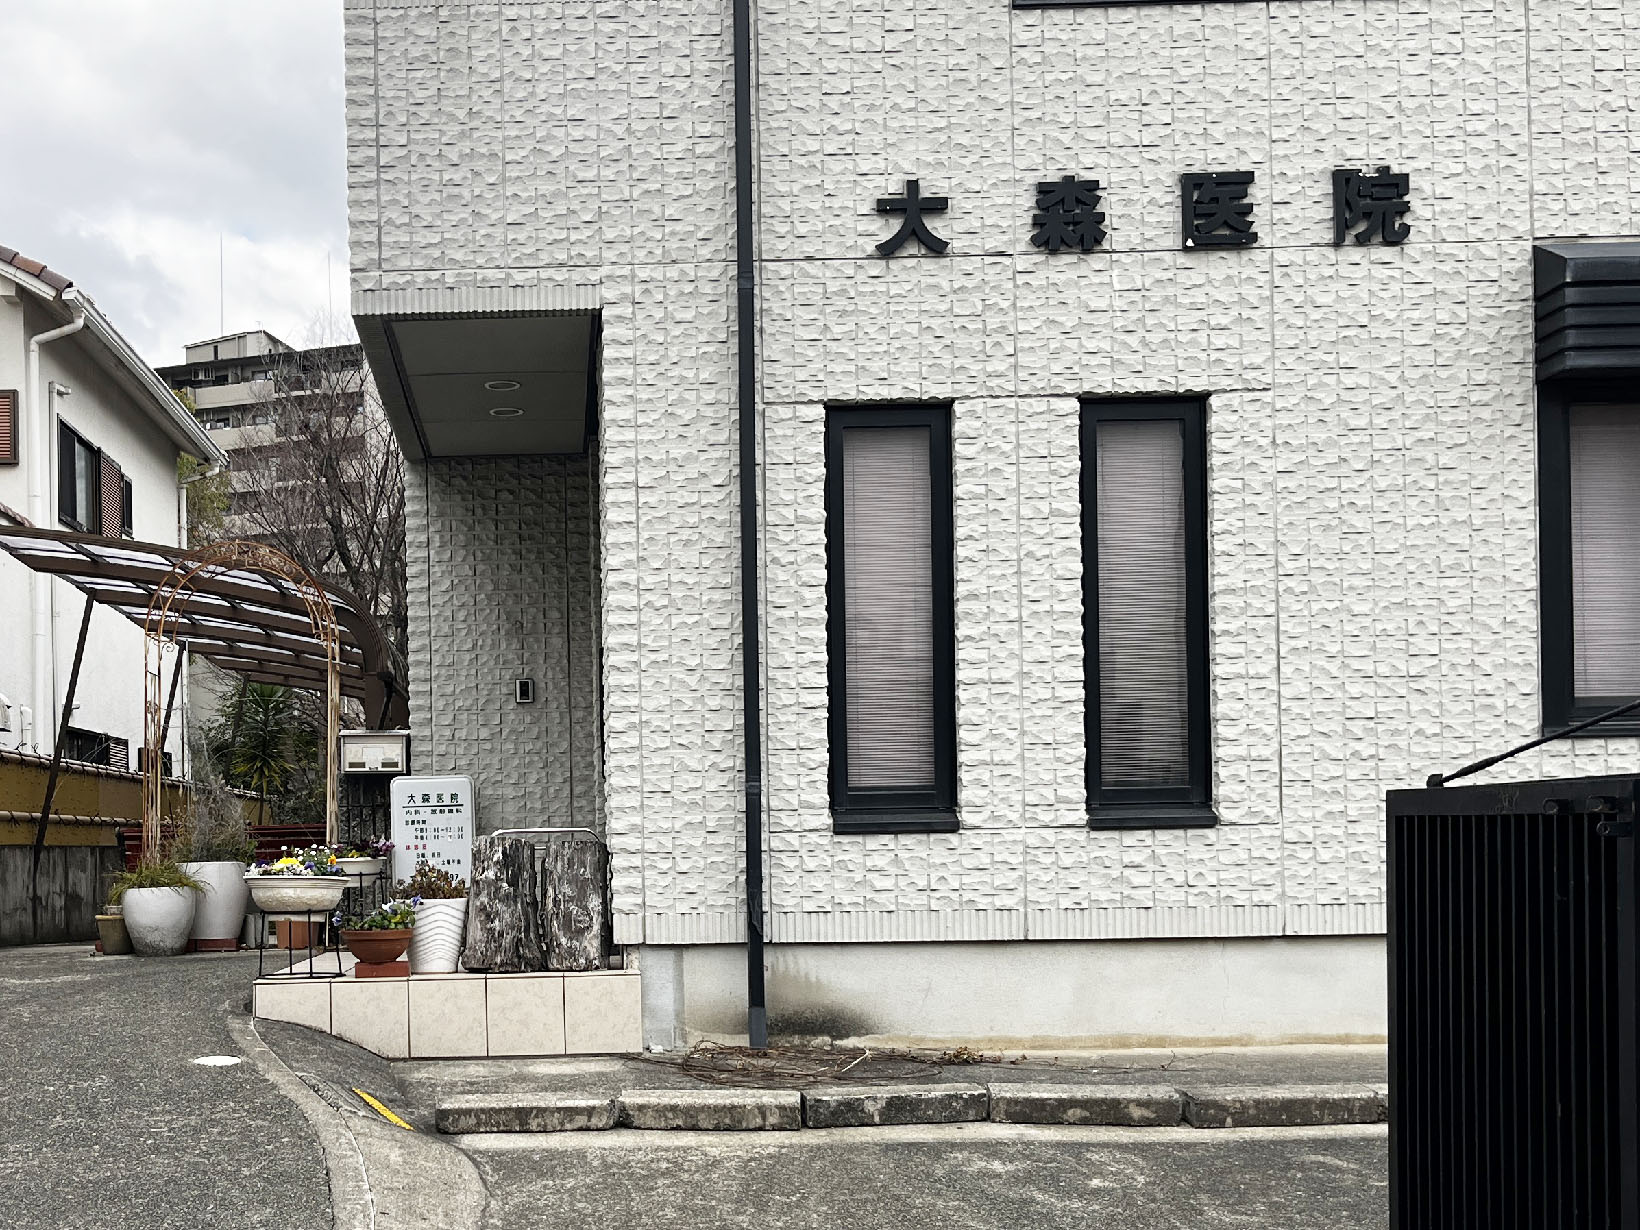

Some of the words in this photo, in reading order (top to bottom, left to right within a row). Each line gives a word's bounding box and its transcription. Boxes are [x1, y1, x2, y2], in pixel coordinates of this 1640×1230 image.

[876, 166, 1410, 256] 大森医院
[407, 793, 459, 804] 大森医院
